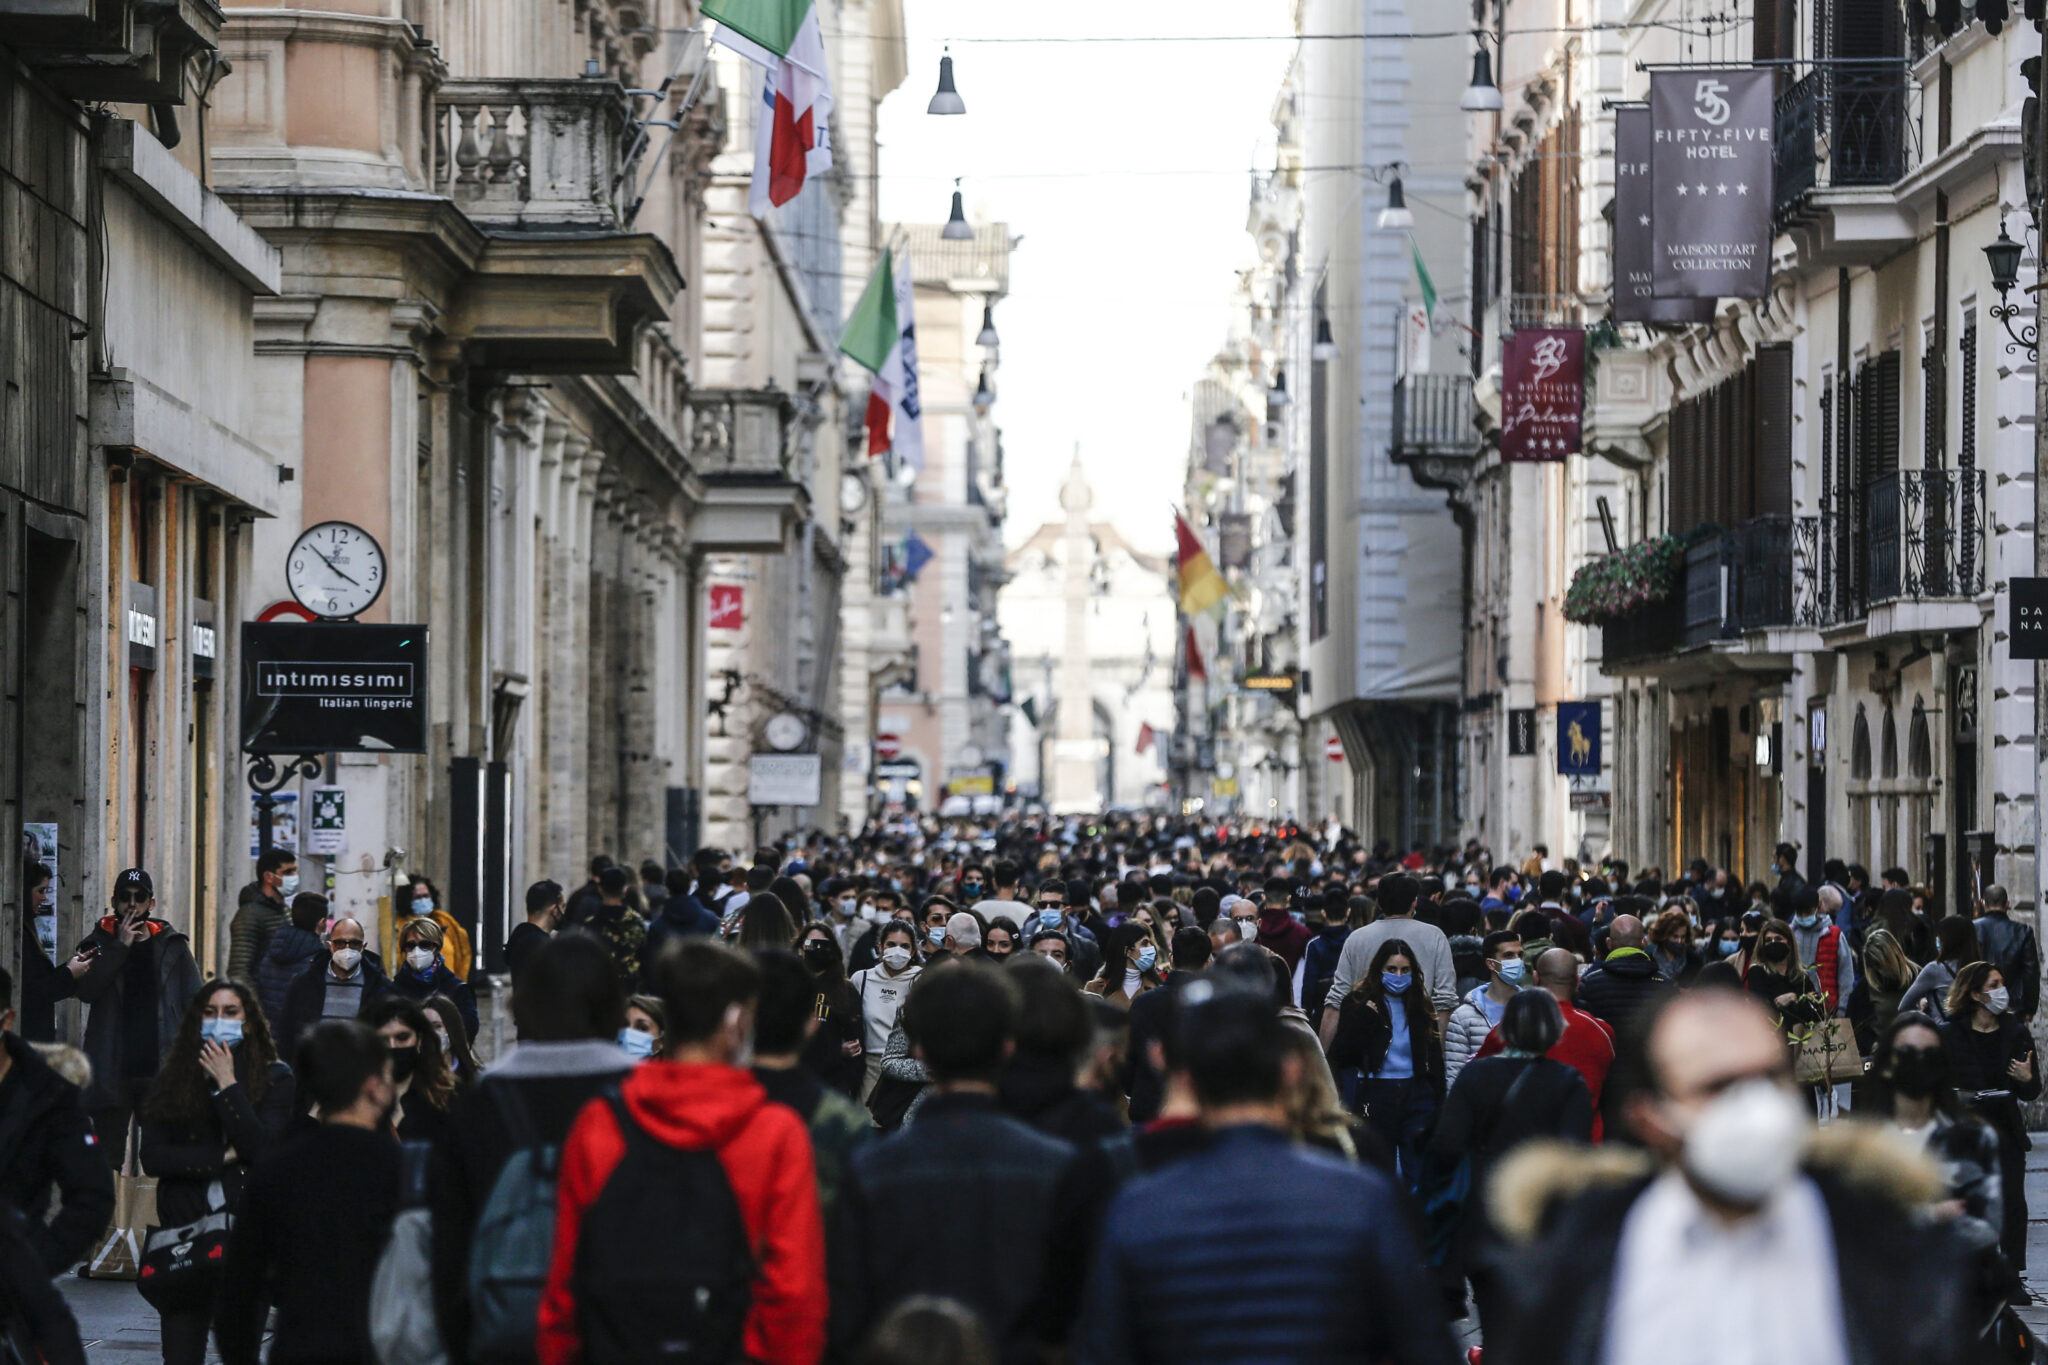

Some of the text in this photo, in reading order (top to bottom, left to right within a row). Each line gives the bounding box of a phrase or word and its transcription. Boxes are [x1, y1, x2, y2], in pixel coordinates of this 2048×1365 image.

[1694, 79, 1730, 125] 55
[1655, 128, 1769, 142] FIFTY-FIVE
[1686, 145, 1738, 159] HOTEL
[1619, 162, 1649, 176] FIF
[1667, 243, 1757, 256] MAISON D'ART
[1672, 258, 1751, 271] COLLECTION
[1629, 271, 1652, 283] MAI
[1634, 285, 1652, 297] CO
[1518, 382, 1577, 393] BOUTIQUE
[1516, 402, 1579, 427] Palace
[1531, 425, 1562, 435] HOTEL
[331, 528, 349, 544] 12
[294, 560, 304, 575] 9
[368, 566, 378, 582] 3
[327, 597, 338, 612] 6
[2020, 607, 2043, 616] DA
[2020, 621, 2043, 630] NA
[267, 671, 404, 688] intimissimi
[319, 698, 413, 710] Italian lingerie
